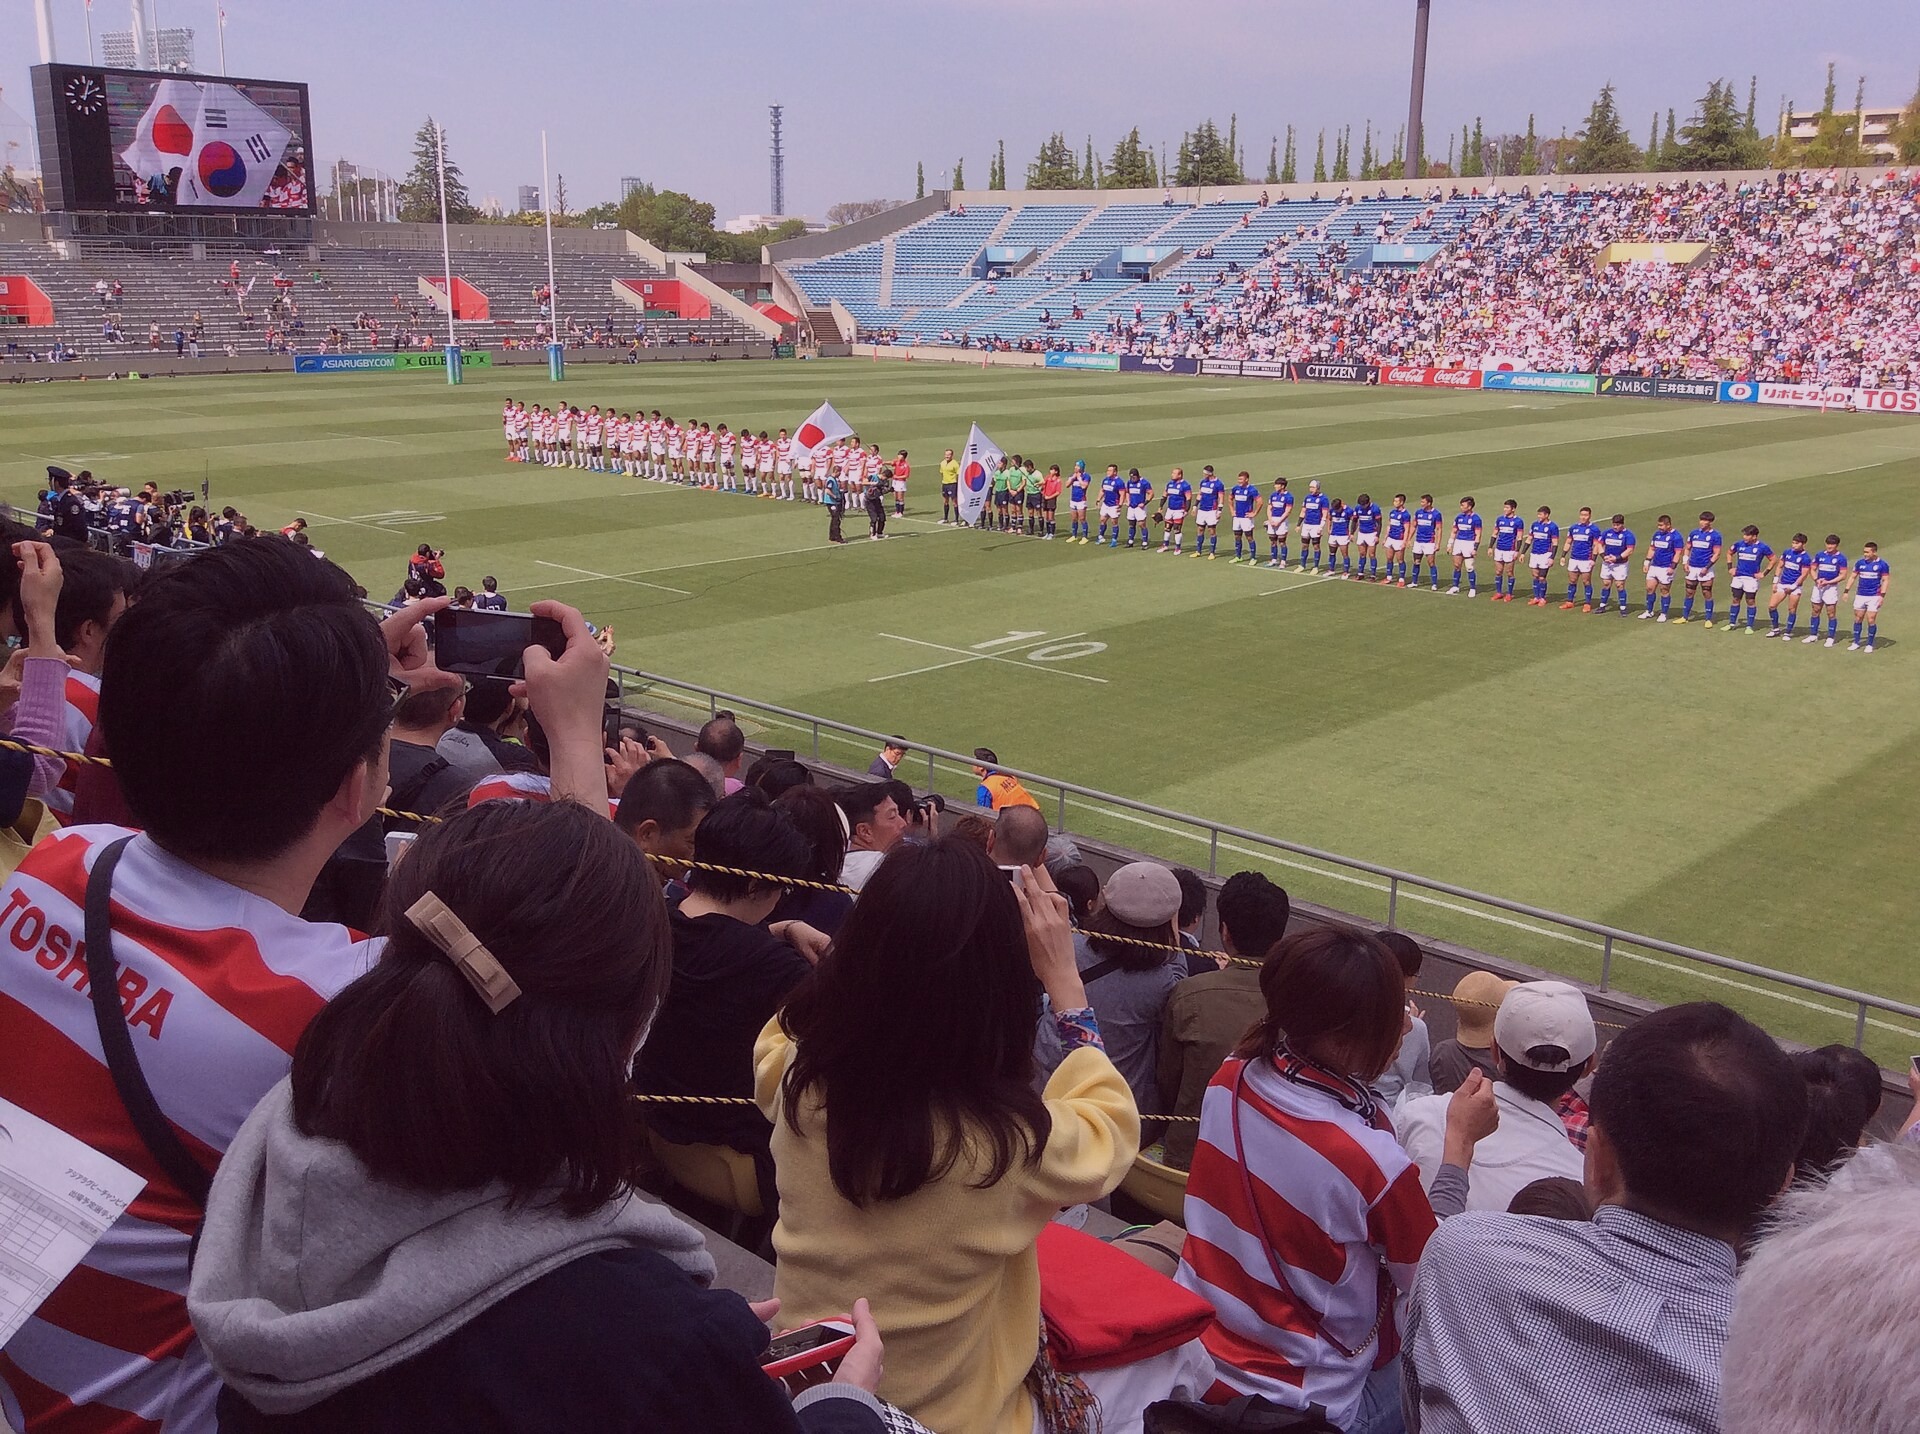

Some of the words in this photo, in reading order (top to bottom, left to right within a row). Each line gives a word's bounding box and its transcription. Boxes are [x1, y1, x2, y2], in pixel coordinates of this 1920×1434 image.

[322, 358, 395, 369] ASIARUGBY.COM
[418, 355, 472, 367] GILBT
[1306, 365, 1358, 379] CITIZEN
[1614, 380, 1650, 393] SMBC
[1658, 383, 1714, 396] 三井住友銀行
[969, 630, 1109, 662] 10
[0, 887, 175, 1041] TOSHBA
